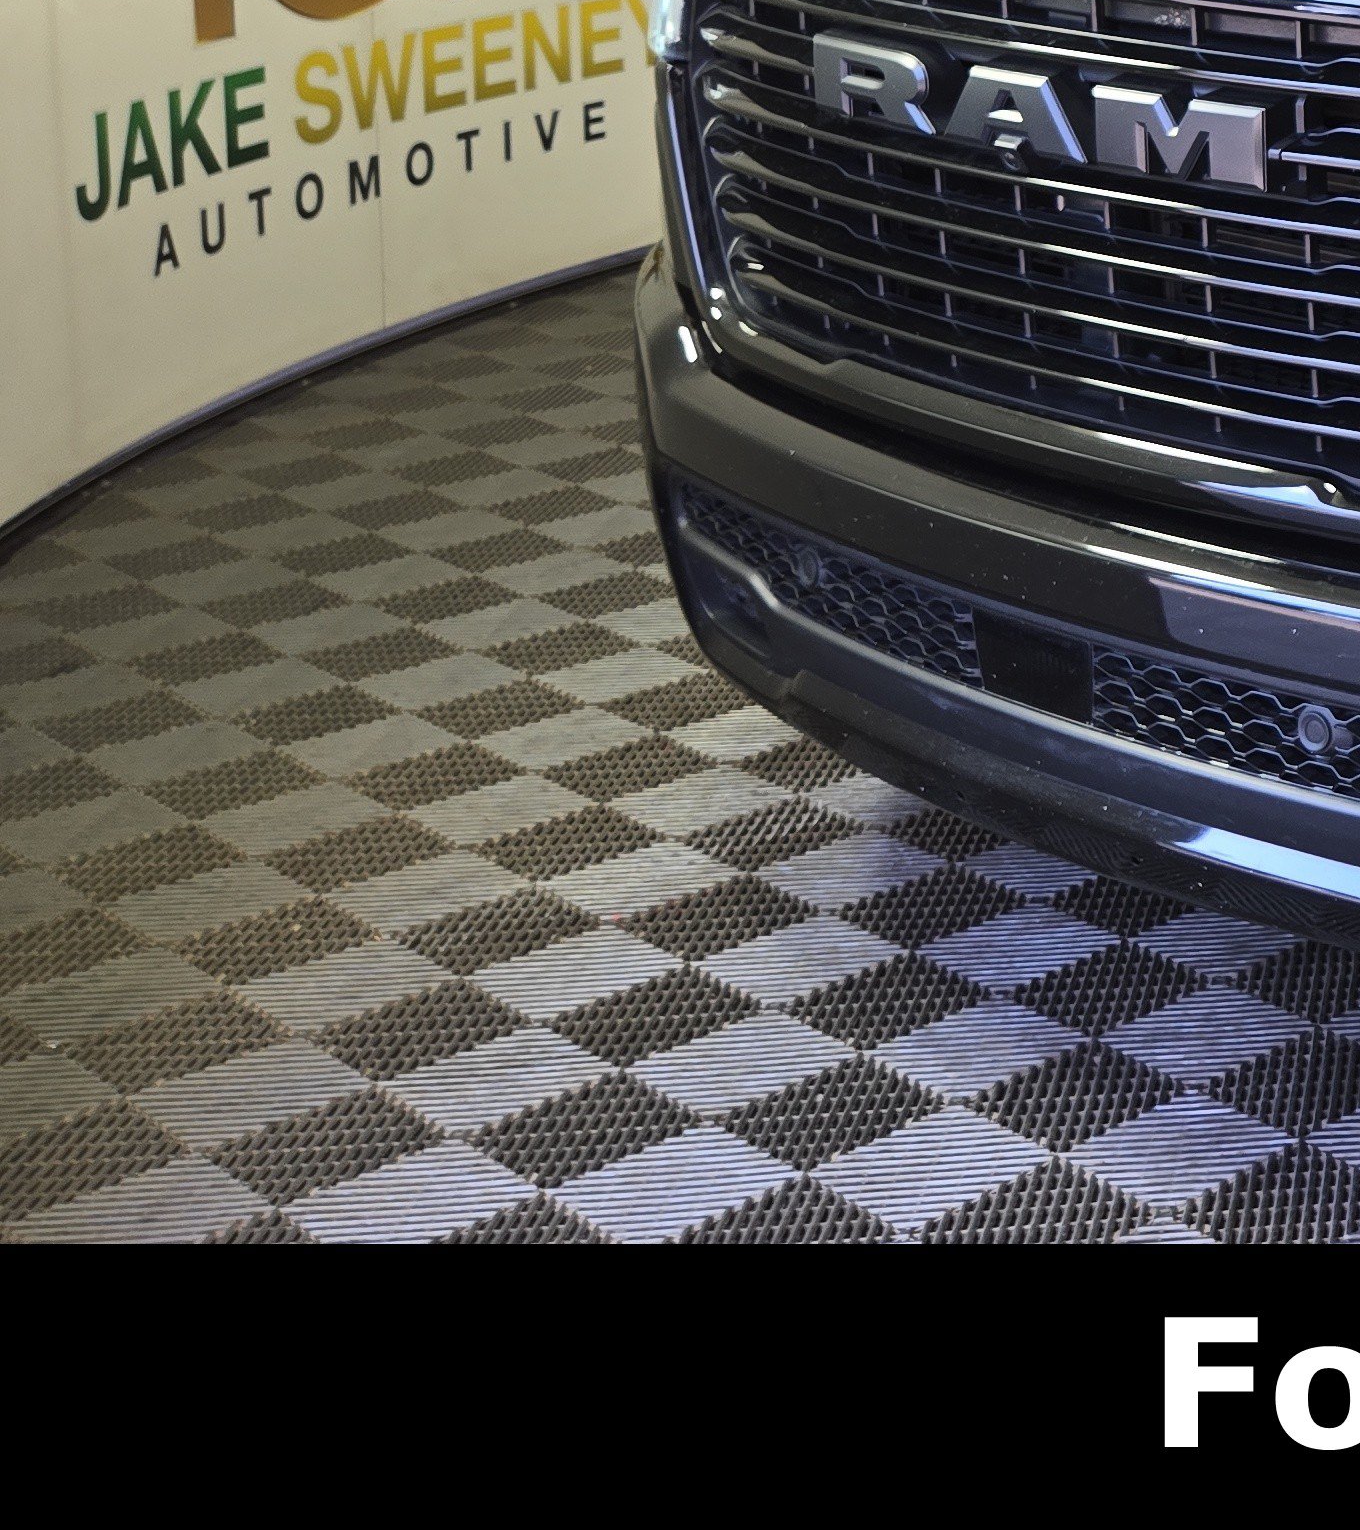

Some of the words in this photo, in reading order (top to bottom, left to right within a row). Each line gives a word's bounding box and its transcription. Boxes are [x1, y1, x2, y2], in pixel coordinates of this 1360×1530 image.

[75, 66, 270, 223] JAKE
[154, 101, 607, 277] AUTOMOTIVE
[813, 32, 1268, 192] RAM
